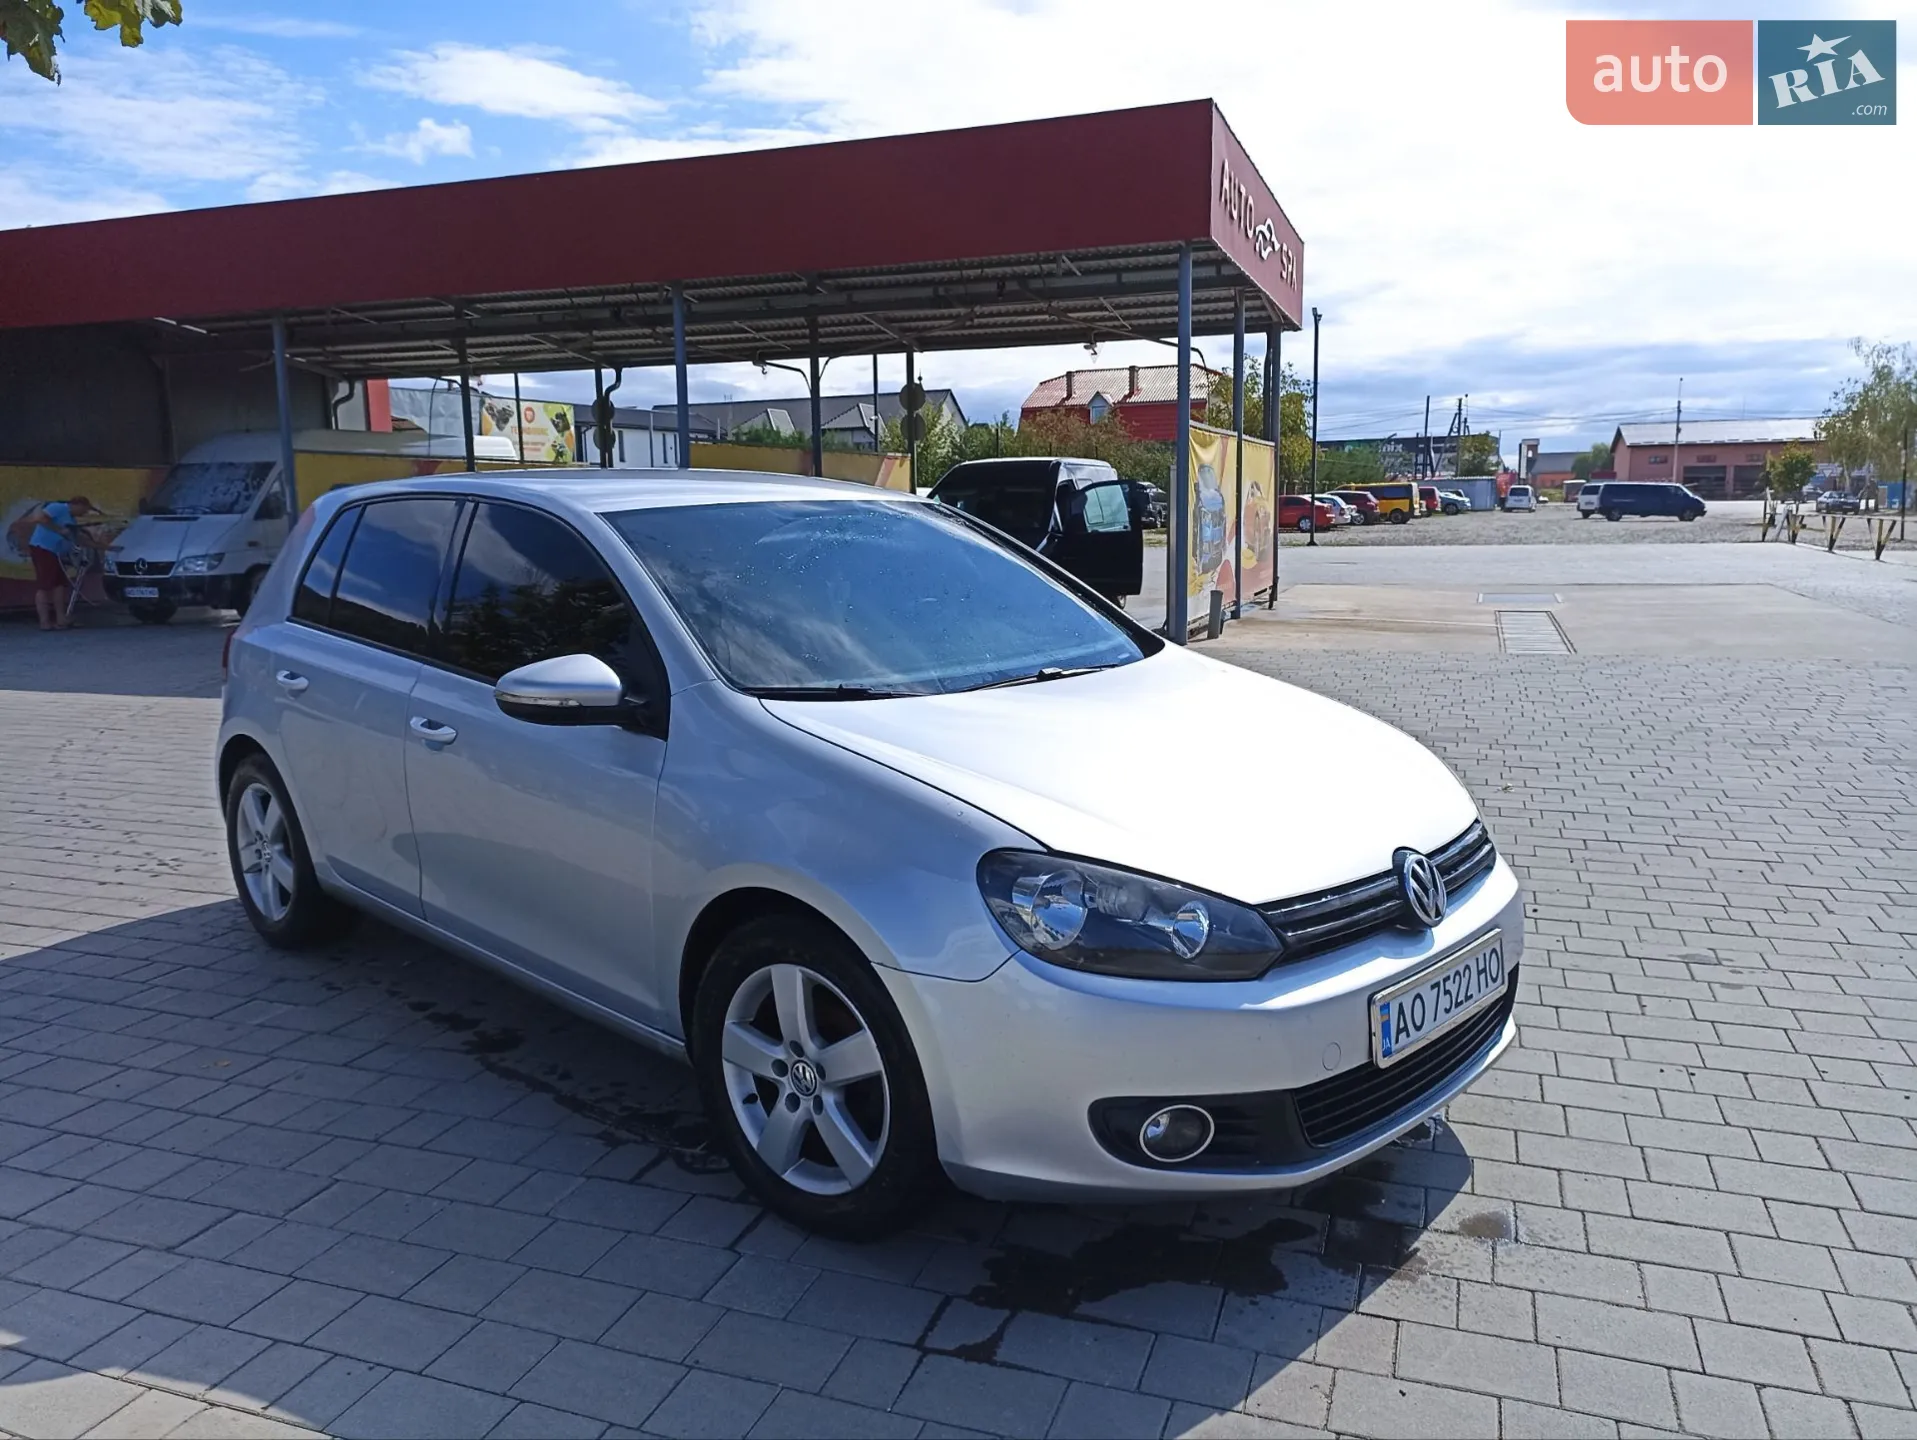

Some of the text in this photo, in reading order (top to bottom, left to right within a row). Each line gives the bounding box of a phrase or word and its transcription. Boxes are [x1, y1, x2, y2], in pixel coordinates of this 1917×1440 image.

[1220, 158, 1298, 292] AUTO SPA
[1395, 947, 1500, 1045] AO 7522 HO
